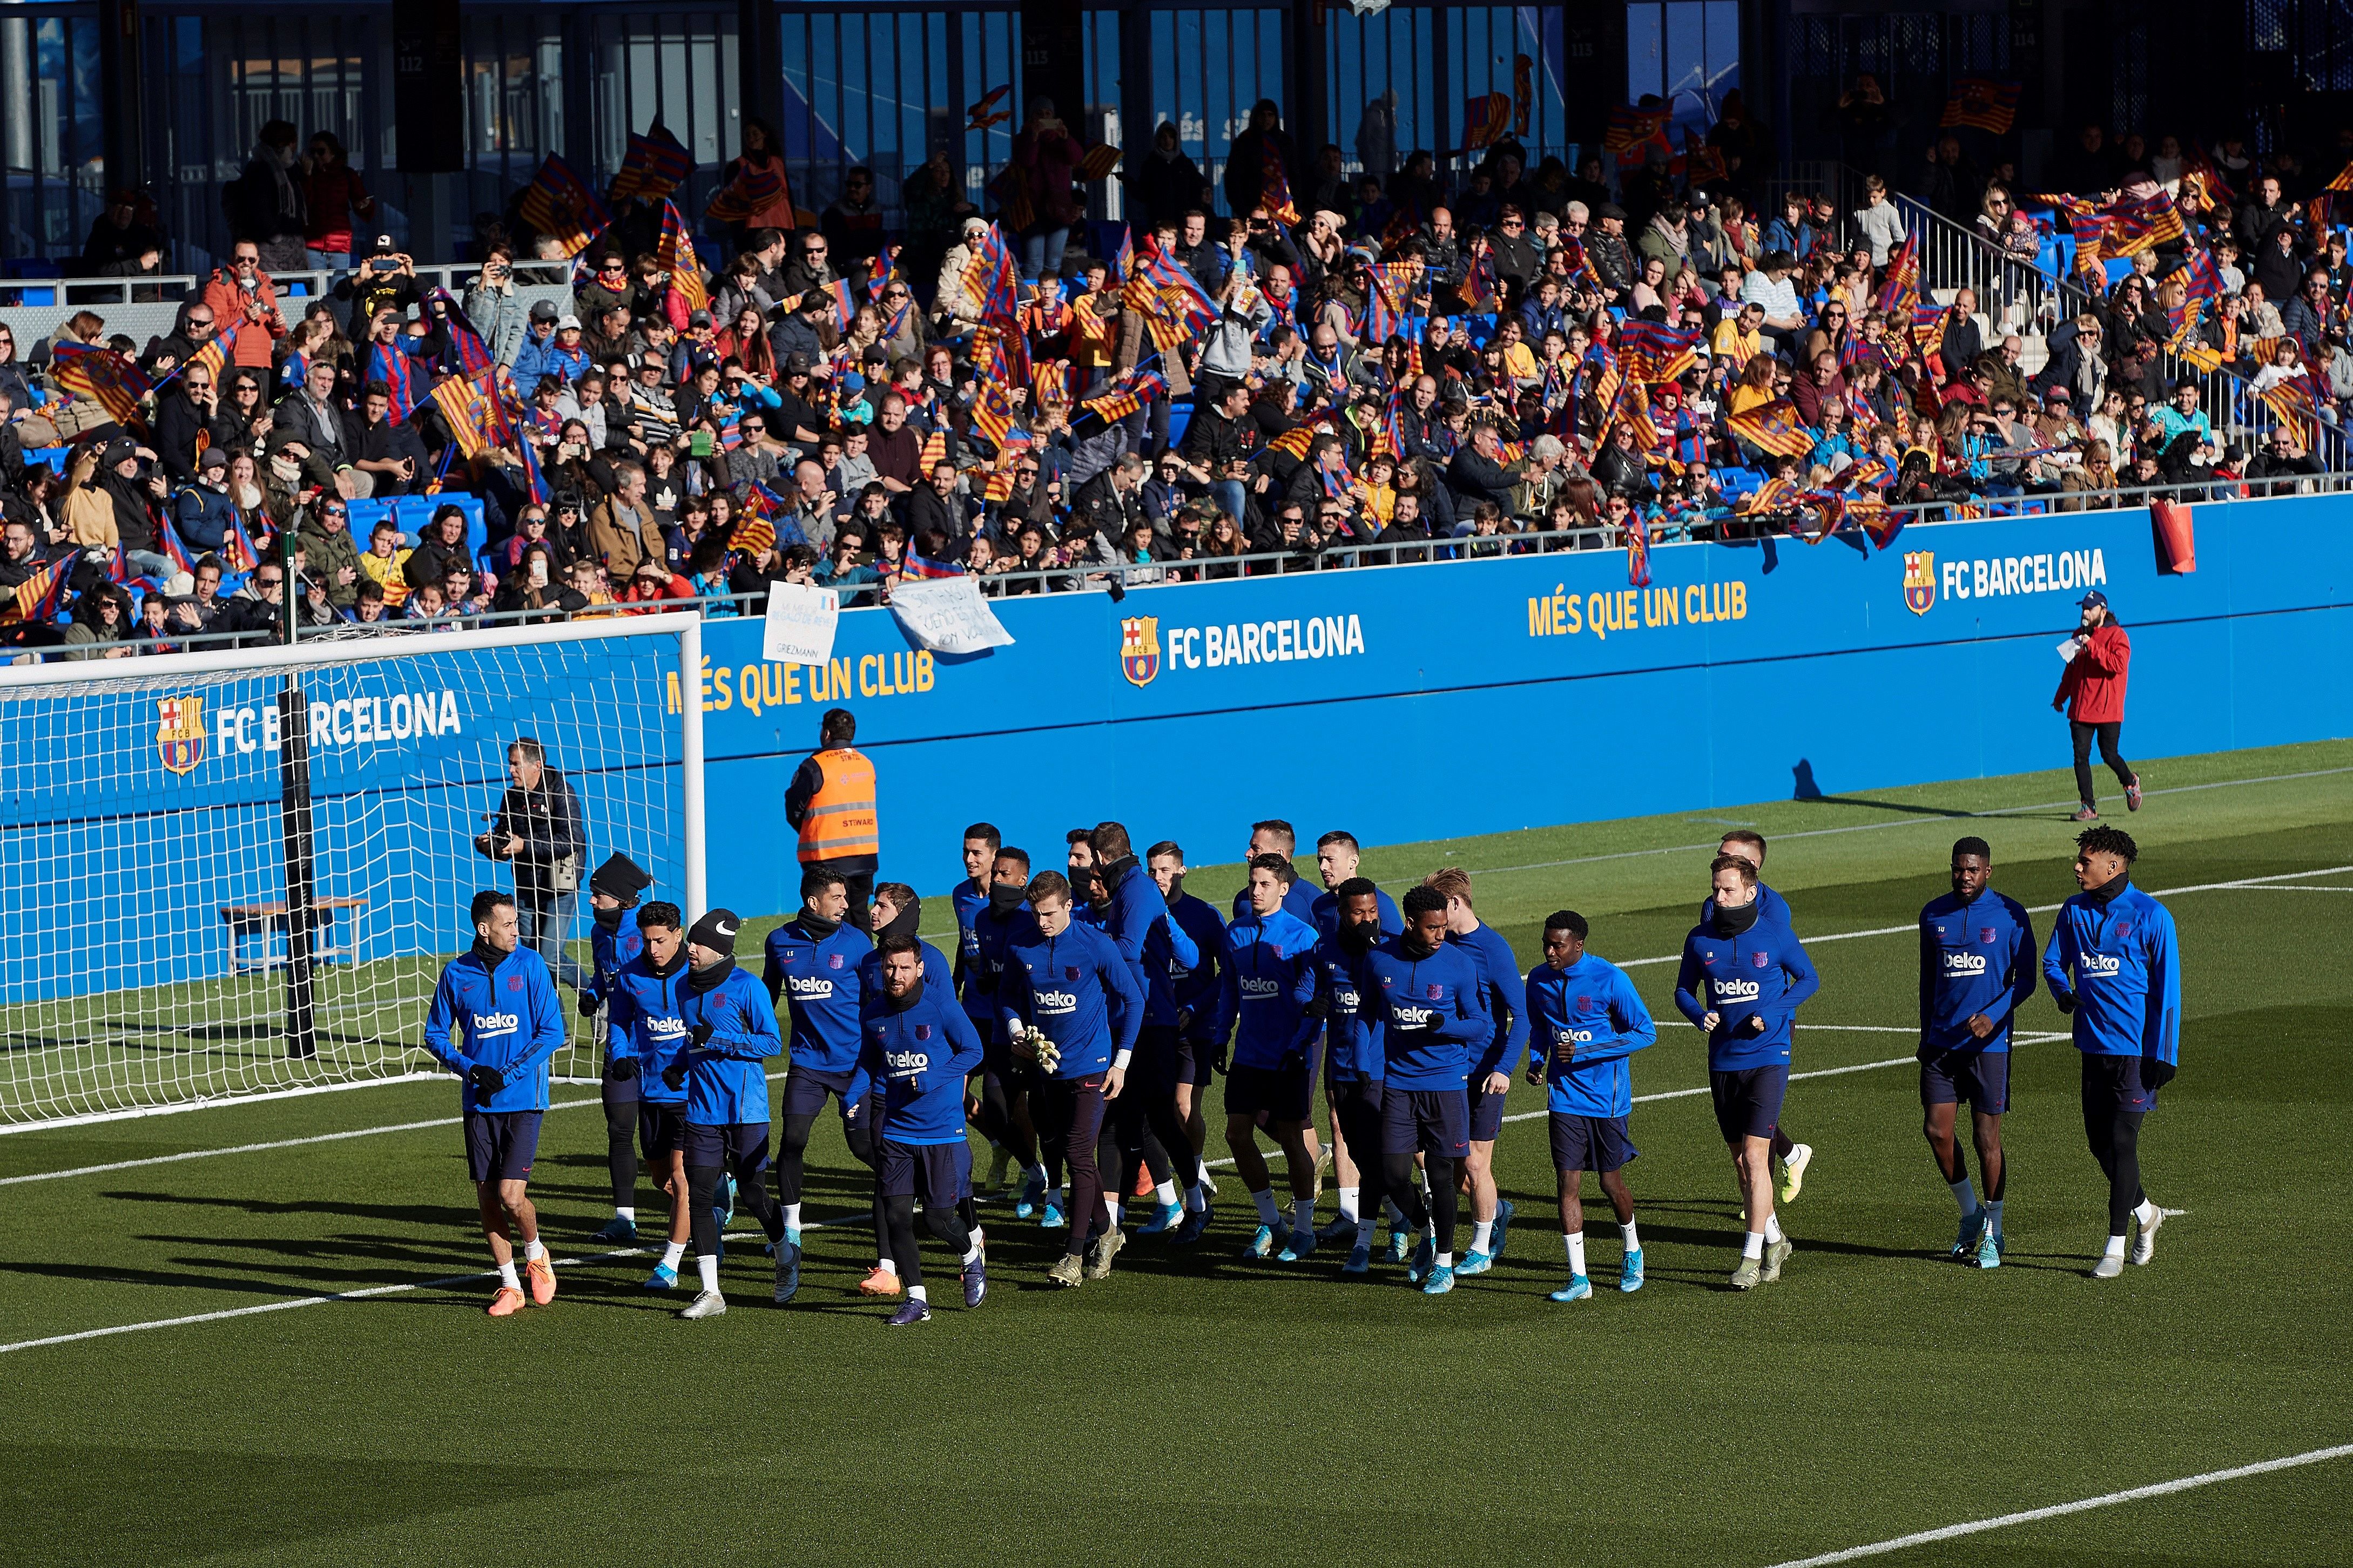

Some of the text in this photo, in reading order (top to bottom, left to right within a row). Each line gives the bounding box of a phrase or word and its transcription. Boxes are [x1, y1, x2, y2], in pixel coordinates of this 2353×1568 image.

[398, 56, 423, 72] 112
[1026, 50, 1049, 65] 113
[1943, 548, 2107, 600] FC BARCELONA
[1528, 581, 1747, 640] MÉS QUE UN CLUB
[776, 643, 818, 658] GRIEZMANN
[1132, 646, 1148, 654] FCB
[1168, 614, 1365, 670] FC BARCELONA
[739, 662, 802, 717] QUE
[810, 657, 852, 702] UN
[859, 650, 935, 698] CLUB
[217, 690, 461, 755] FC BRCELONA
[172, 729, 190, 739] FCB
[963, 925, 978, 941] be
[1943, 951, 1986, 969] beko
[2080, 952, 2120, 970] beko
[789, 975, 833, 992] beko
[1240, 975, 1278, 992] beko
[1713, 978, 1759, 995] beko
[1033, 989, 1076, 1007] beko
[1334, 987, 1361, 1005] bek
[473, 1012, 518, 1029] beko
[1552, 1025, 1592, 1043] beko
[885, 1050, 928, 1067] beko
